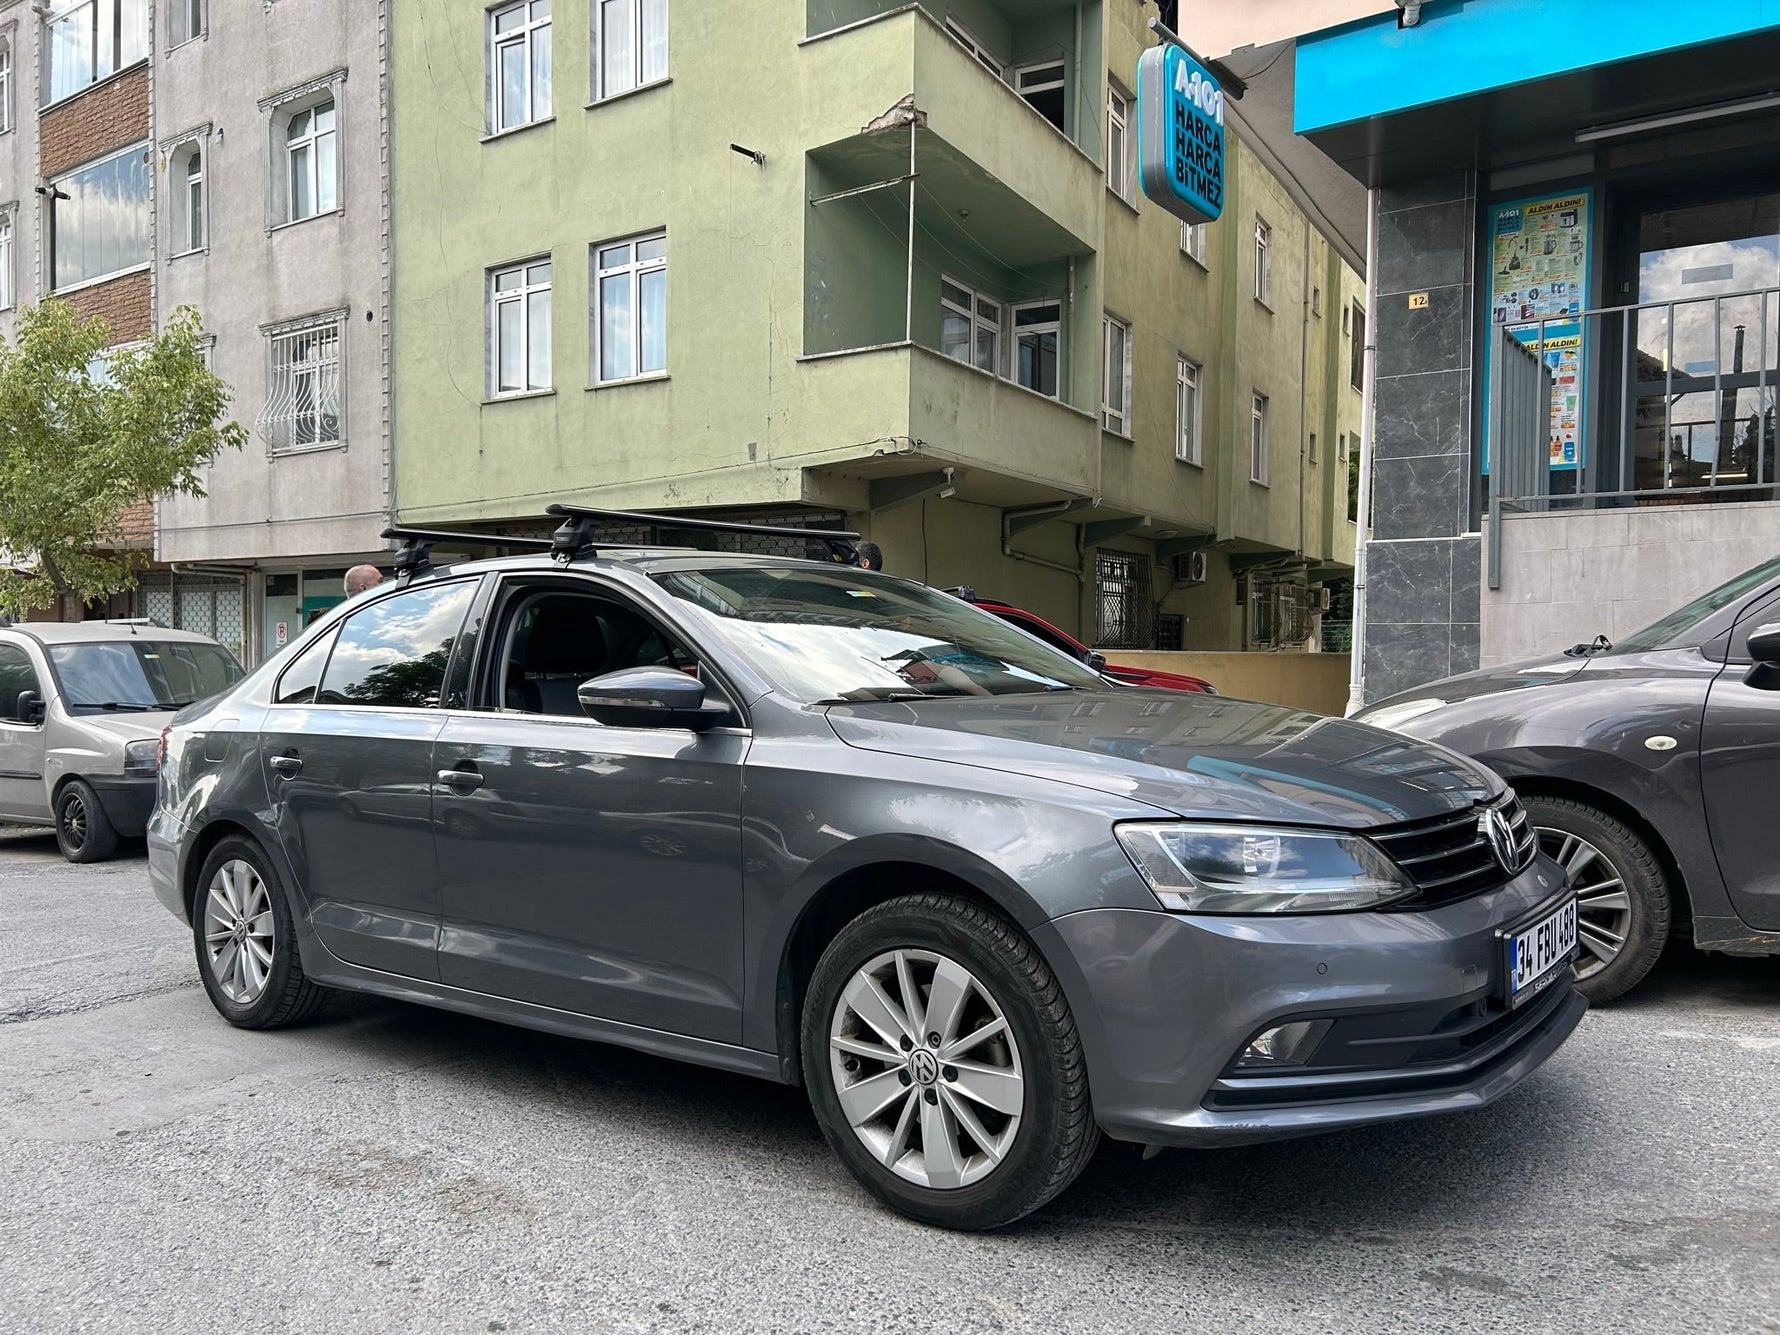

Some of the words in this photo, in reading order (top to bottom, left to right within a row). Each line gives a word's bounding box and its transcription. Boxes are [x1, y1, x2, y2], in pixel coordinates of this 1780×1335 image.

[1176, 99, 1222, 153] HARCA
[1176, 128, 1222, 184] HARCA
[1528, 204, 1553, 215] ALDIN
[1553, 197, 1582, 209] ALDIN!
[1526, 342, 1550, 351] ALDN
[1550, 338, 1578, 349] ALDIN!
[1517, 933, 1533, 984] 34
[1537, 916, 1557, 970] FBU
[1558, 903, 1574, 951] 488
